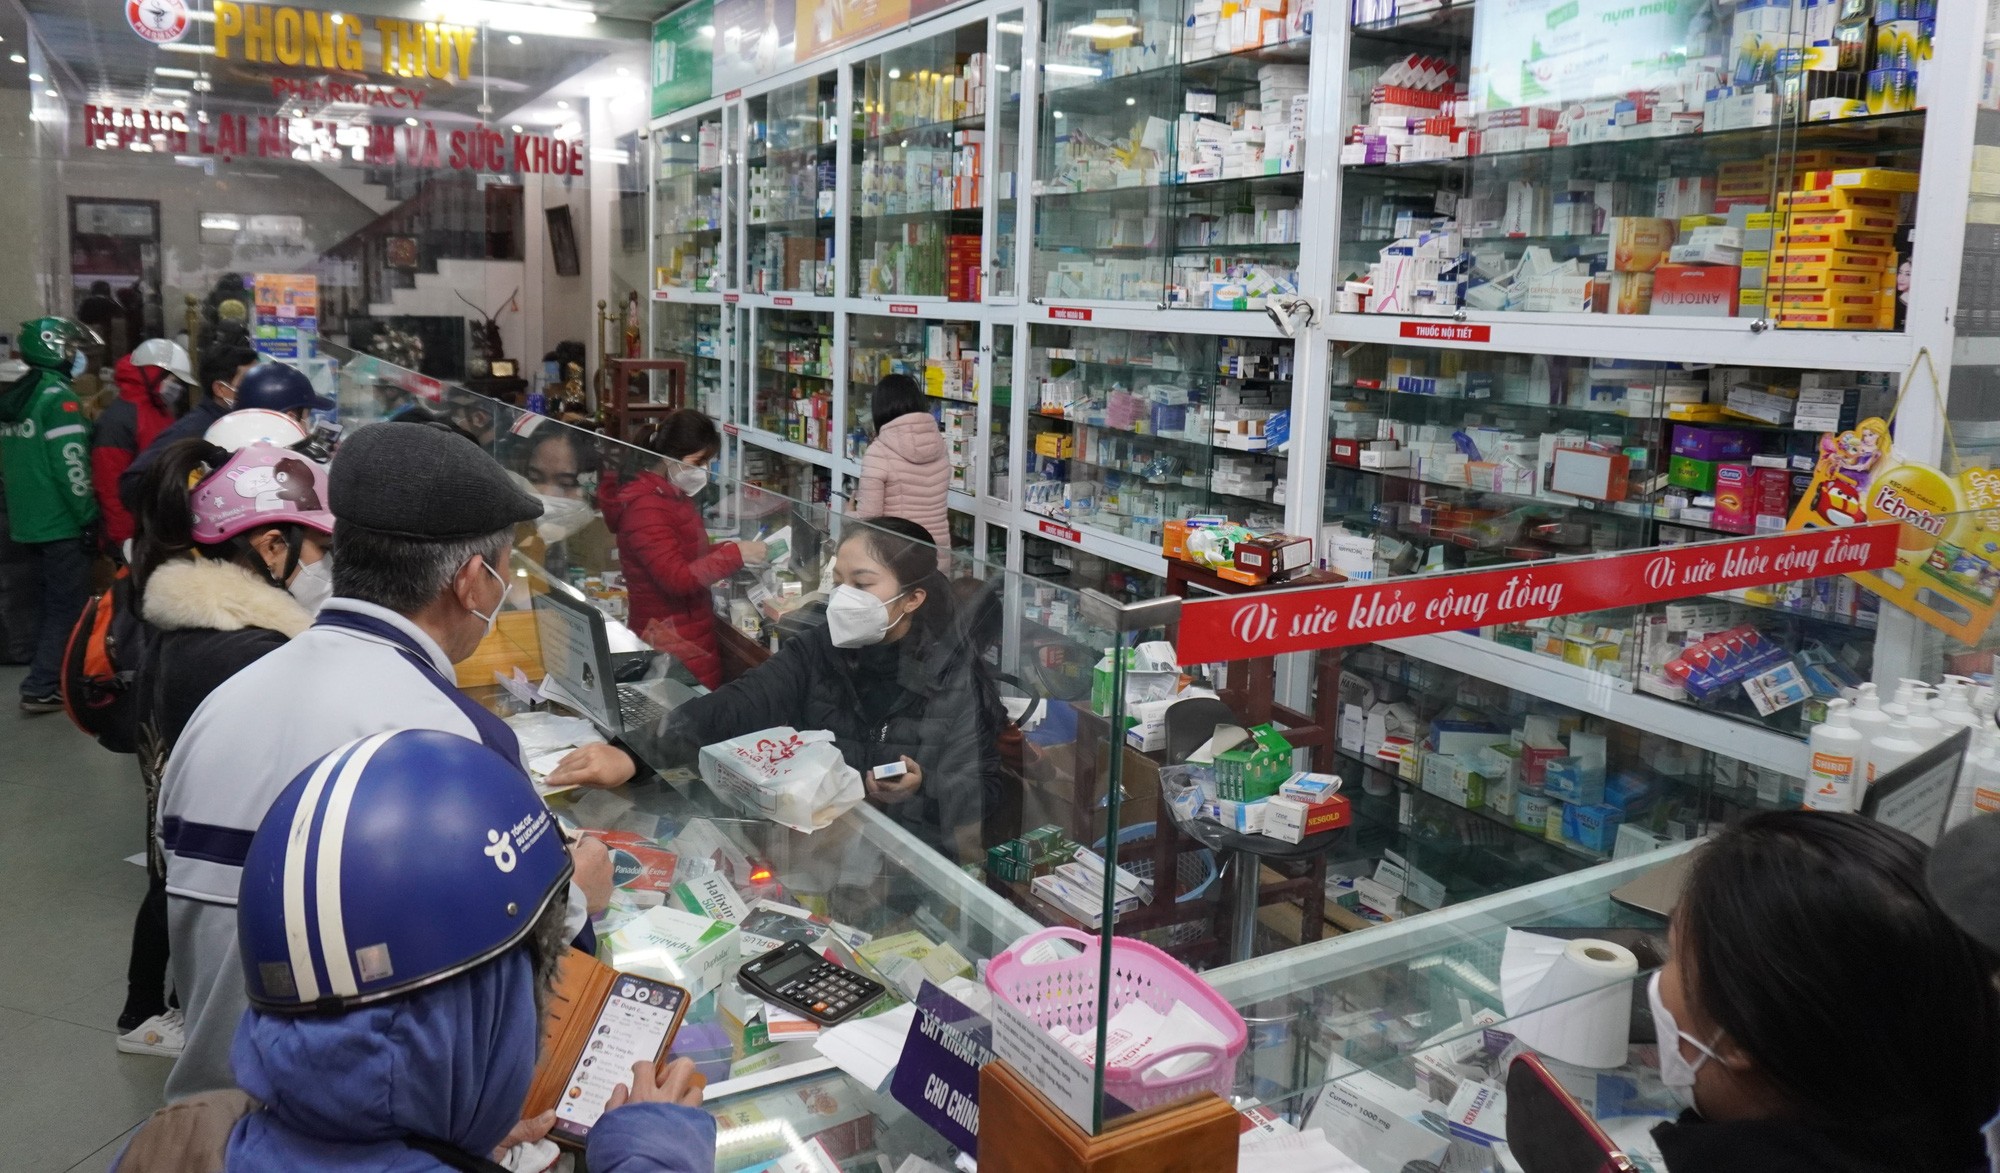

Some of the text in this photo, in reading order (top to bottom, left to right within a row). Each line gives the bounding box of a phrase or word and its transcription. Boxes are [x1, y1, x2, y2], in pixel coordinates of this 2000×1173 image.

[213, 0, 363, 71] PHONG
[272, 77, 426, 110] PHARMACY
[1416, 325, 1473, 339] THUỐC NỘI TIẾT
[1720, 469, 1741, 479] durex
[1645, 534, 1871, 589] Vì sức khỏe cộng đồng
[1231, 574, 1563, 643] Vì sức khỏe cộng đồng
[1308, 812, 1340, 826] NESGOLD
[615, 865, 642, 875] Panadol
[703, 879, 736, 919] Hafixin
[920, 1008, 941, 1041] SÁT
[924, 1073, 949, 1110] CHO
[1463, 1088, 1490, 1125] CEFALEXIN
[1359, 1106, 1377, 1121] 1000
[1377, 1118, 1391, 1130] mg
